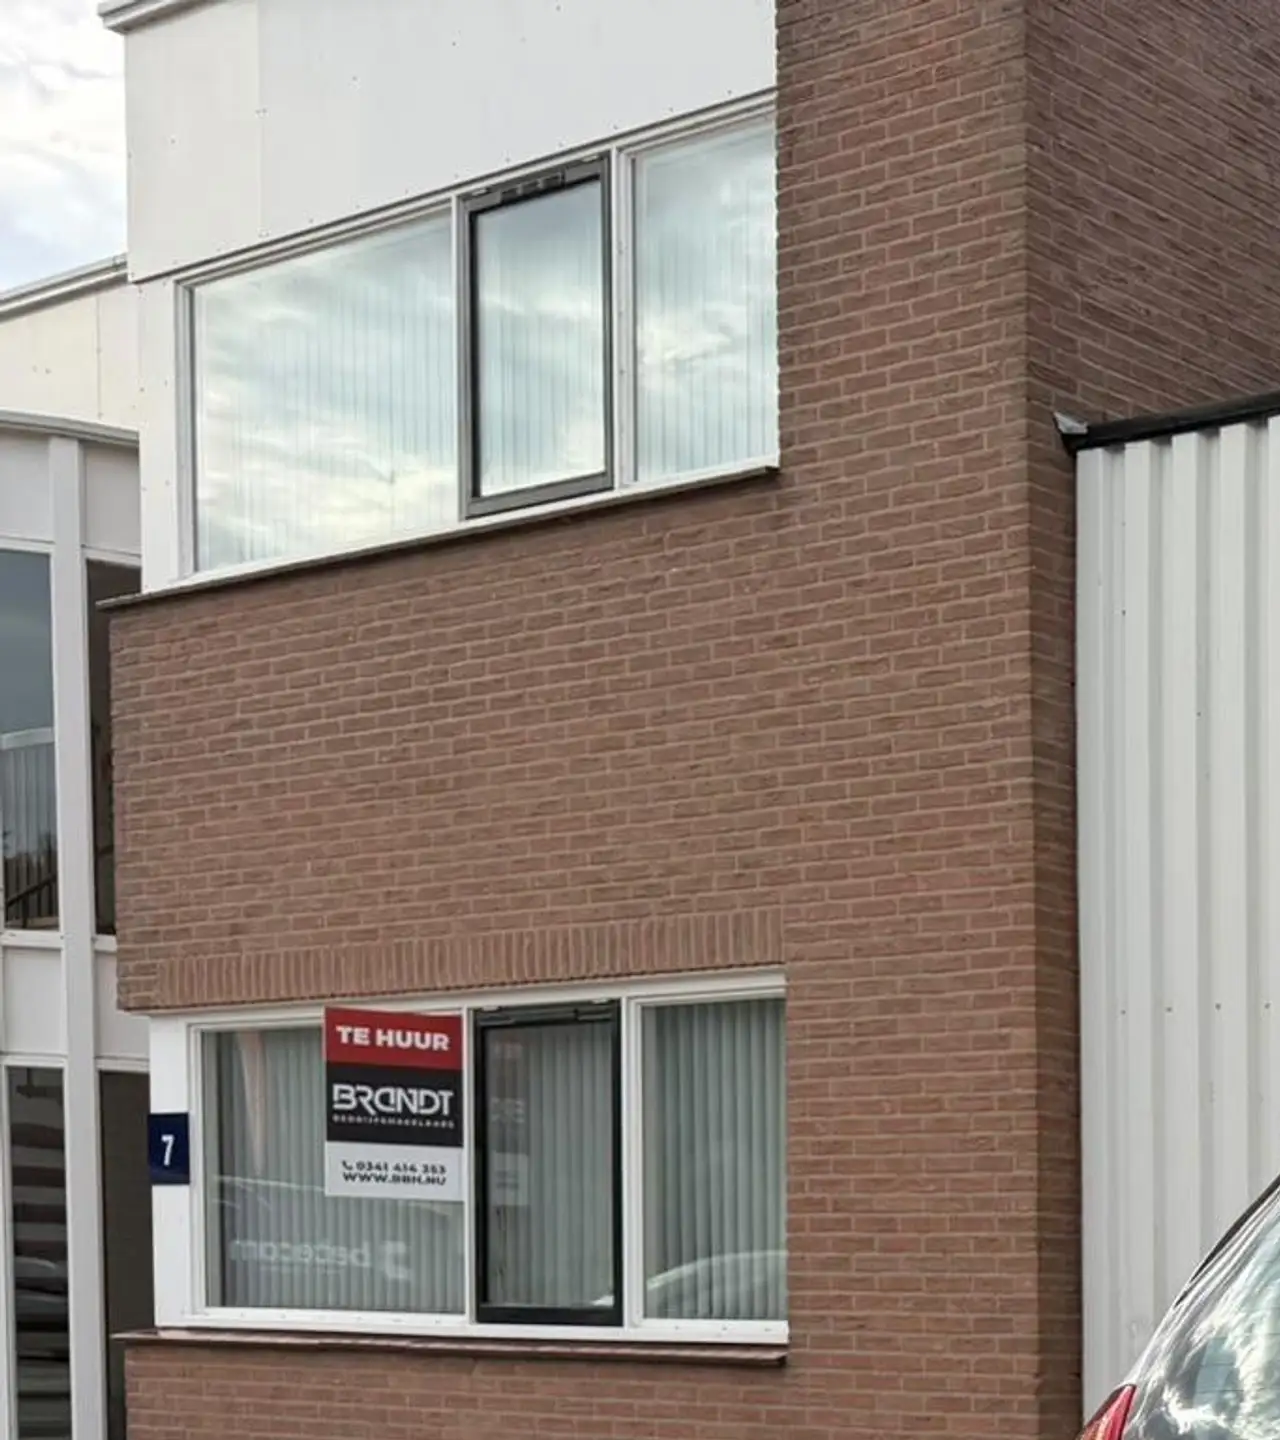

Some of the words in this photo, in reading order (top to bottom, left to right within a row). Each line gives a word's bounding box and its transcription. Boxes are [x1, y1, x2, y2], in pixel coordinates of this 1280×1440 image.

[335, 1024, 370, 1046] TE
[375, 1028, 450, 1051] HUUR
[332, 1083, 454, 1116] BRANDT
[161, 1133, 175, 1167] 7
